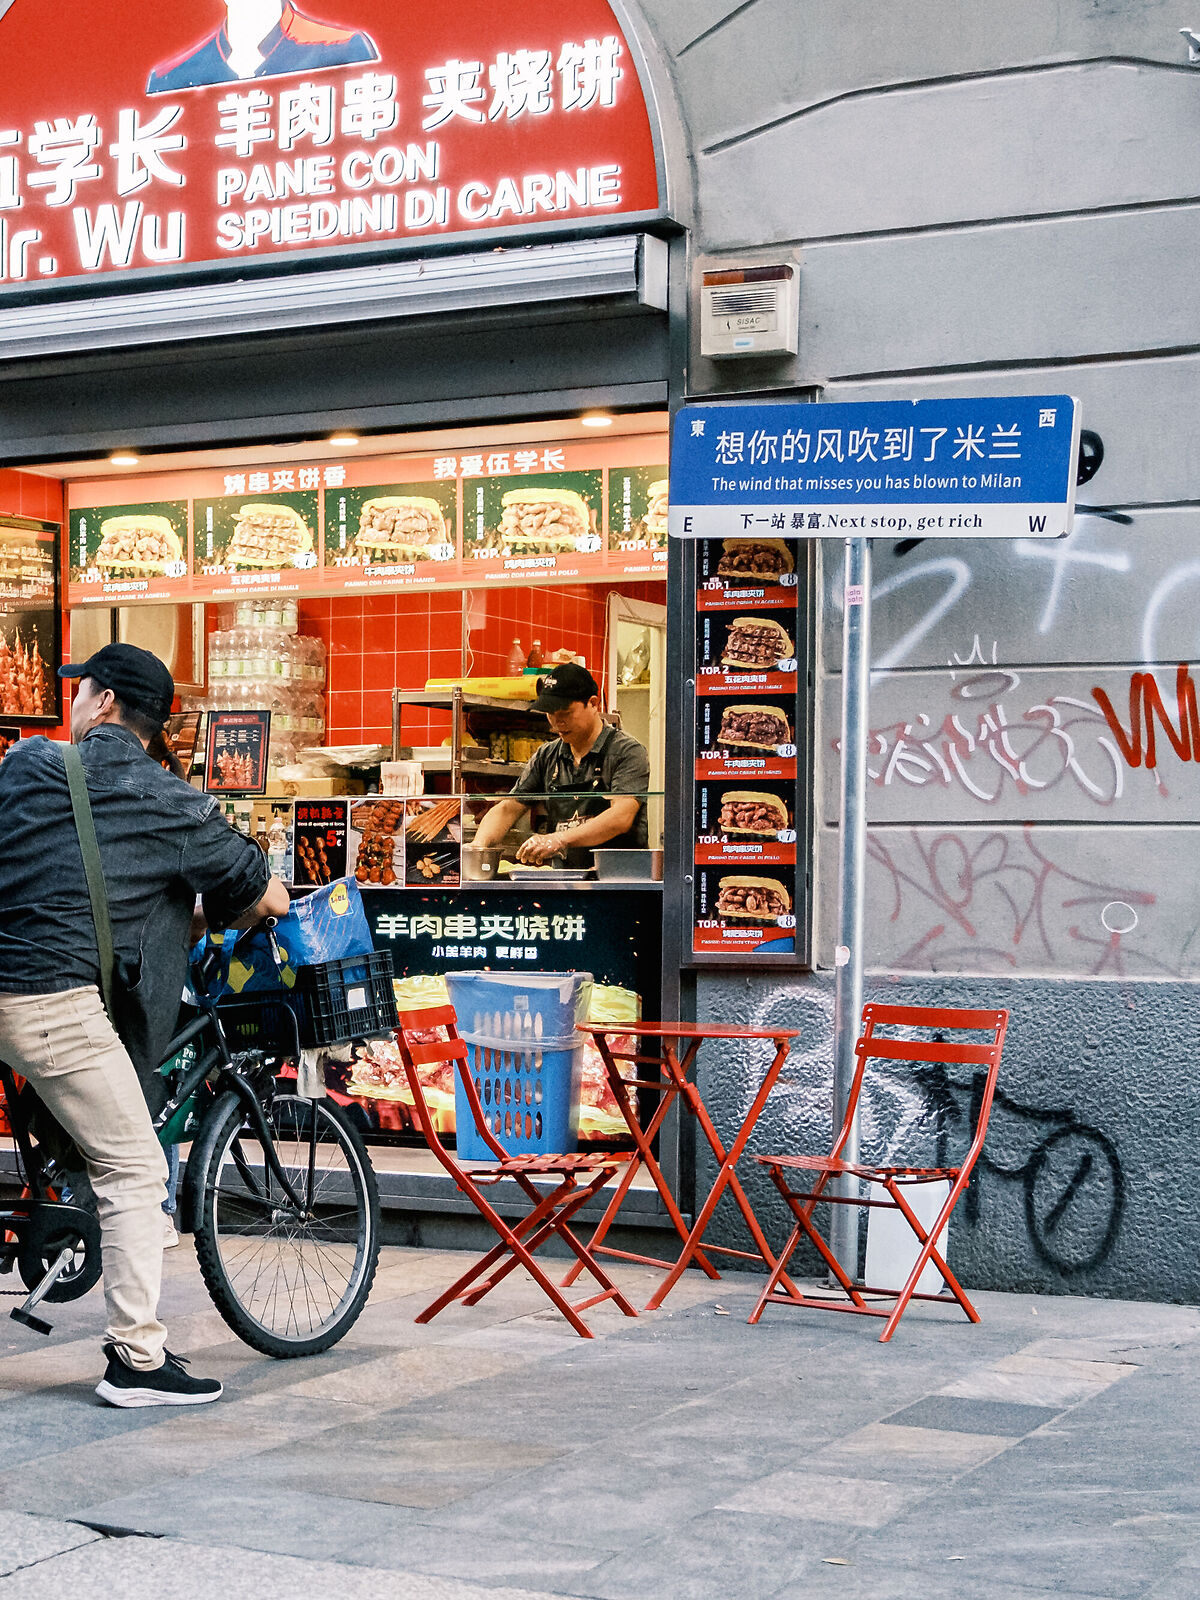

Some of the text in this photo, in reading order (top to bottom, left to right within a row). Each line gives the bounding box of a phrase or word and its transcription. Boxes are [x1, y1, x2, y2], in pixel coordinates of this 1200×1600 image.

[215, 35, 626, 157] 羊肉串 夹烧饼
[216, 141, 440, 207] PANE CON
[216, 163, 623, 253] SPIEDINI DI CARNE
[74, 207, 186, 271] Wu
[690, 419, 707, 438] 東
[1038, 408, 1058, 429] 西
[714, 422, 1023, 465] 想你的风吹到了米兰
[433, 448, 566, 479] 我爱伍学长
[711, 473, 1022, 493] The wind that misses you has blown to Milan
[683, 516, 694, 533] E
[740, 512, 786, 531] 下一站
[871, 514, 912, 531] stop,
[916, 514, 945, 531] get
[948, 513, 983, 528] rich
[1027, 515, 1048, 533] W
[375, 913, 587, 942] 羊肉串夹烧饼
